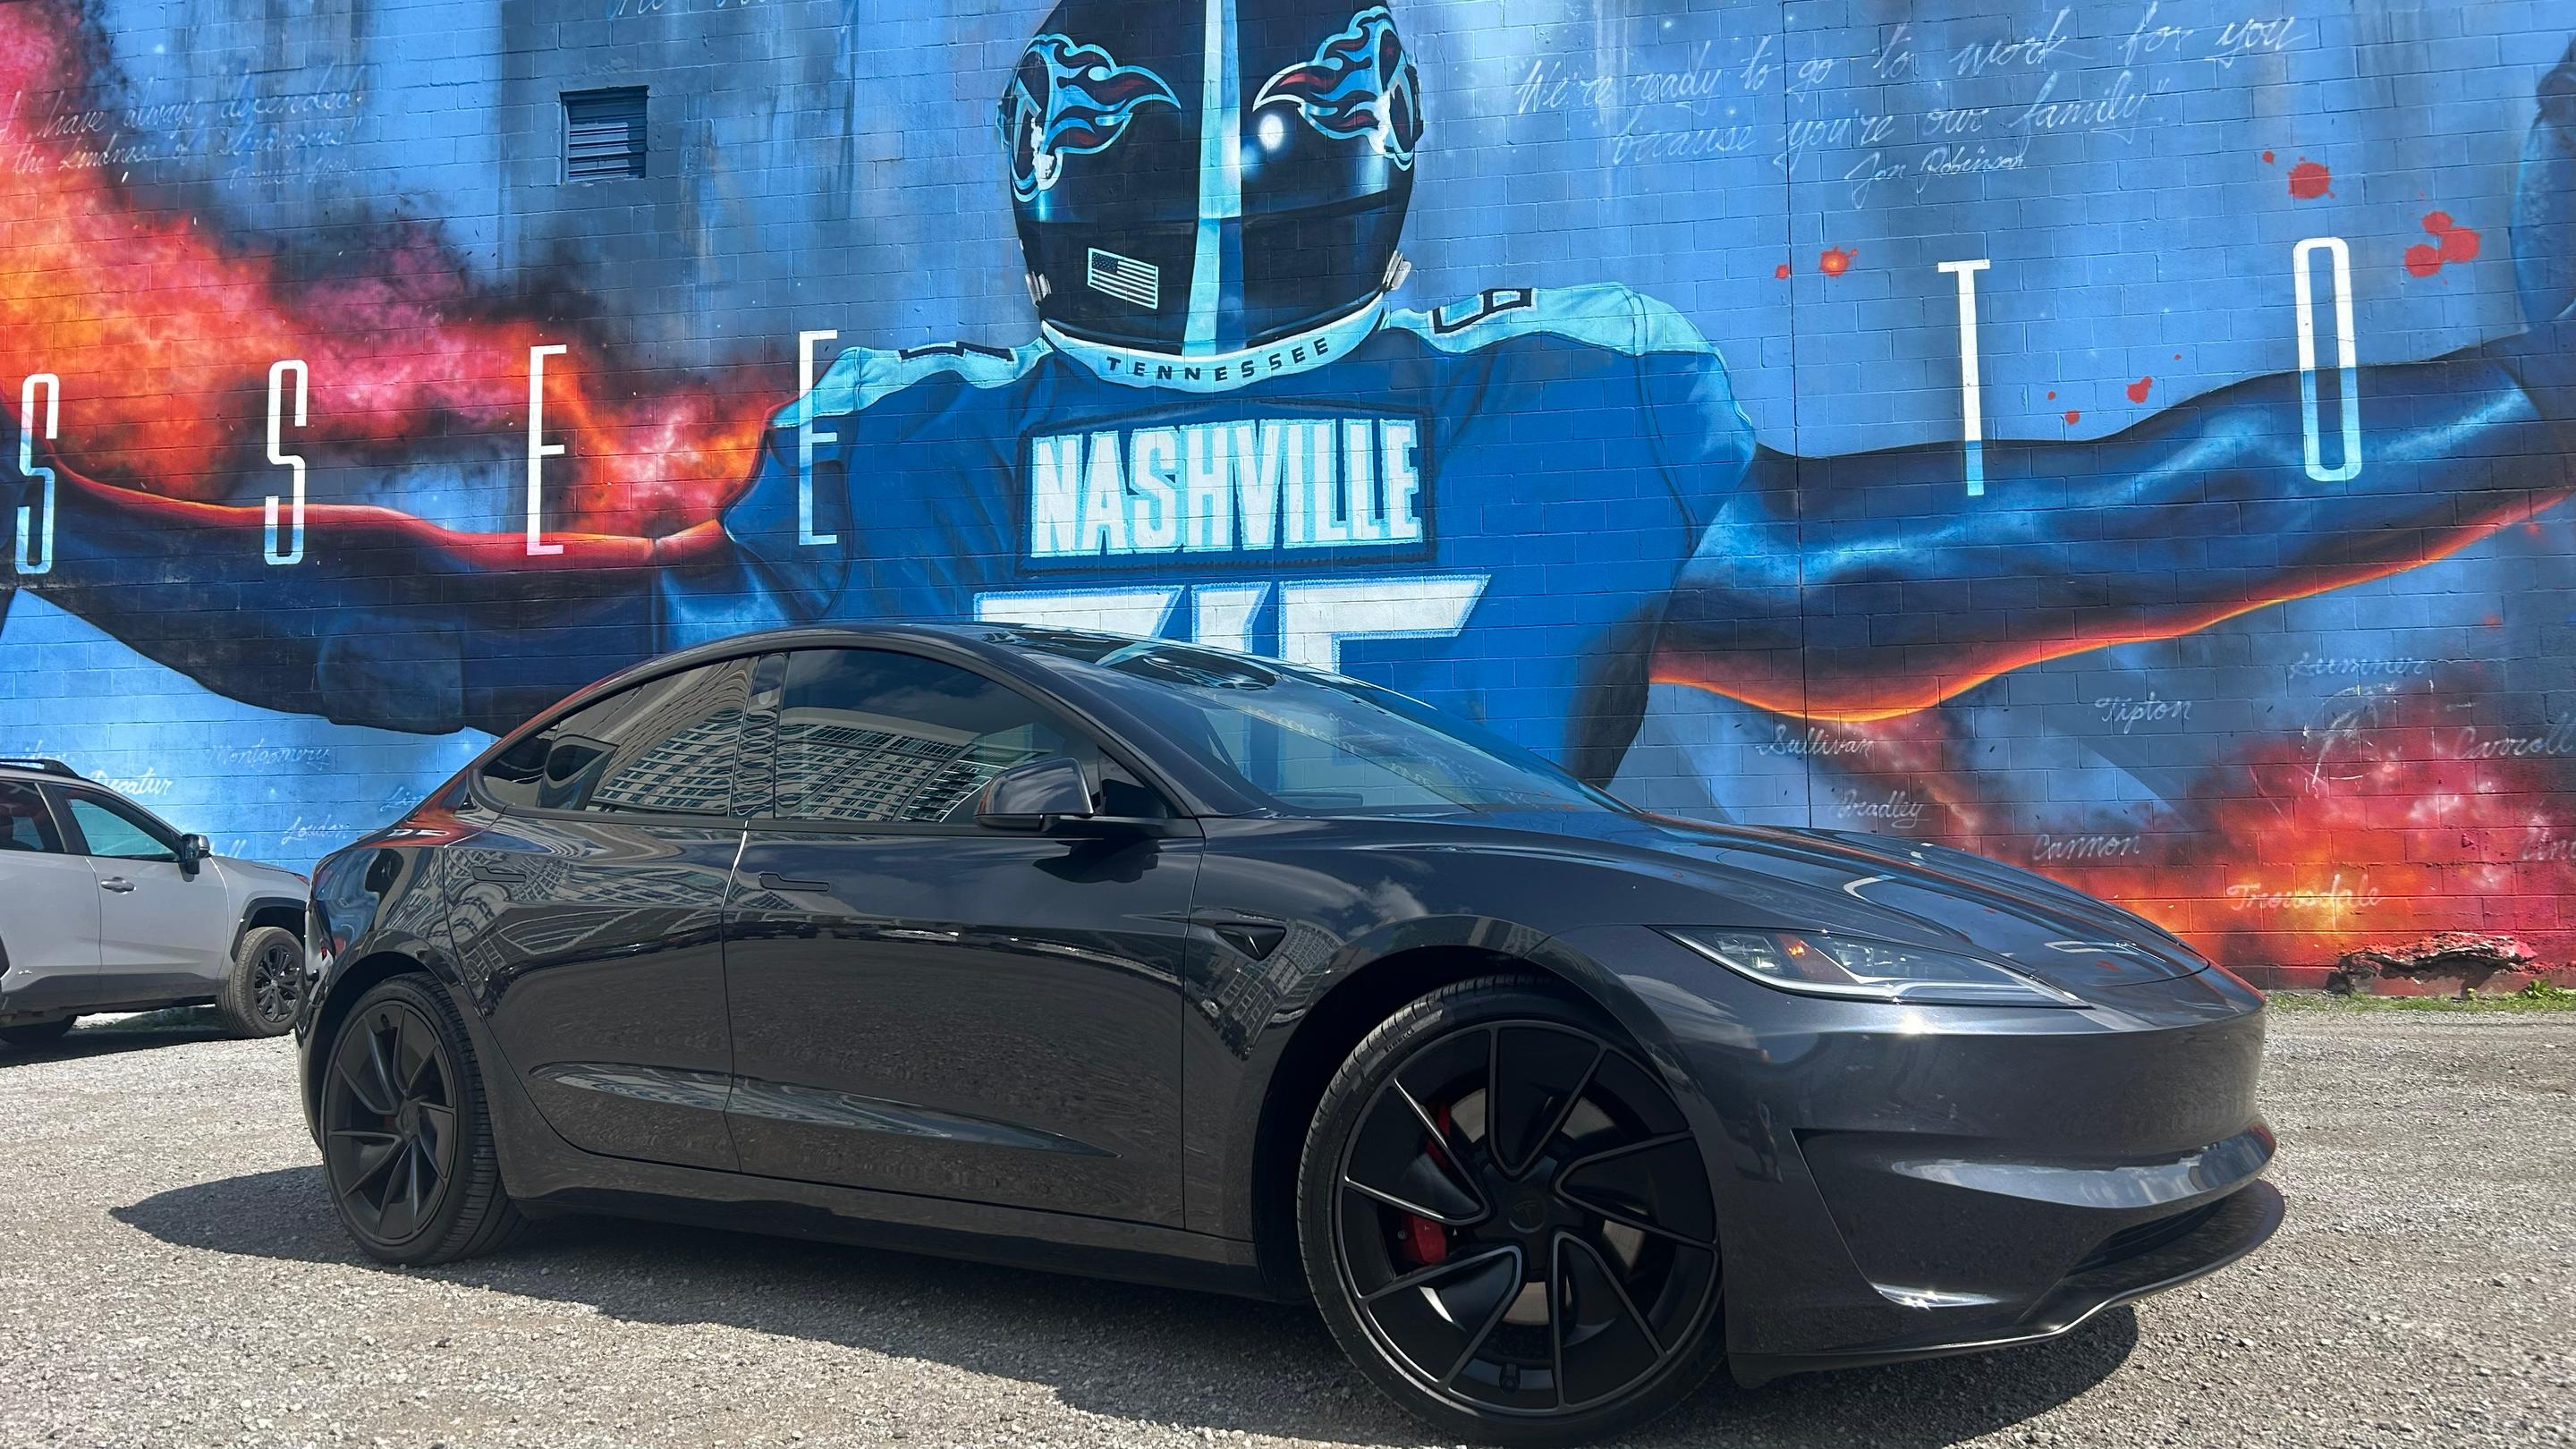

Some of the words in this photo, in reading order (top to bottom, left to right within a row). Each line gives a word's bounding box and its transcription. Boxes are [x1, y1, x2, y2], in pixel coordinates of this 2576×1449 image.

[1631, 40, 1721, 117] ready
[1740, 35, 1782, 90] to
[1784, 56, 1836, 103] go
[1871, 22, 1914, 80] to
[1948, 6, 2095, 76] work
[2118, 1, 2194, 67] for
[2204, 16, 2309, 69] you
[1613, 108, 1758, 165] because
[1922, 107, 1989, 134] our
[1106, 336, 1330, 382] TENNESSEE
[1030, 417, 1424, 559] NASHVILLE
[2095, 691, 2192, 734] Tipton
[1755, 723, 1875, 759] Sullivan
[1835, 788, 1930, 829] Bradley
[2031, 833, 2140, 861] Cannon
